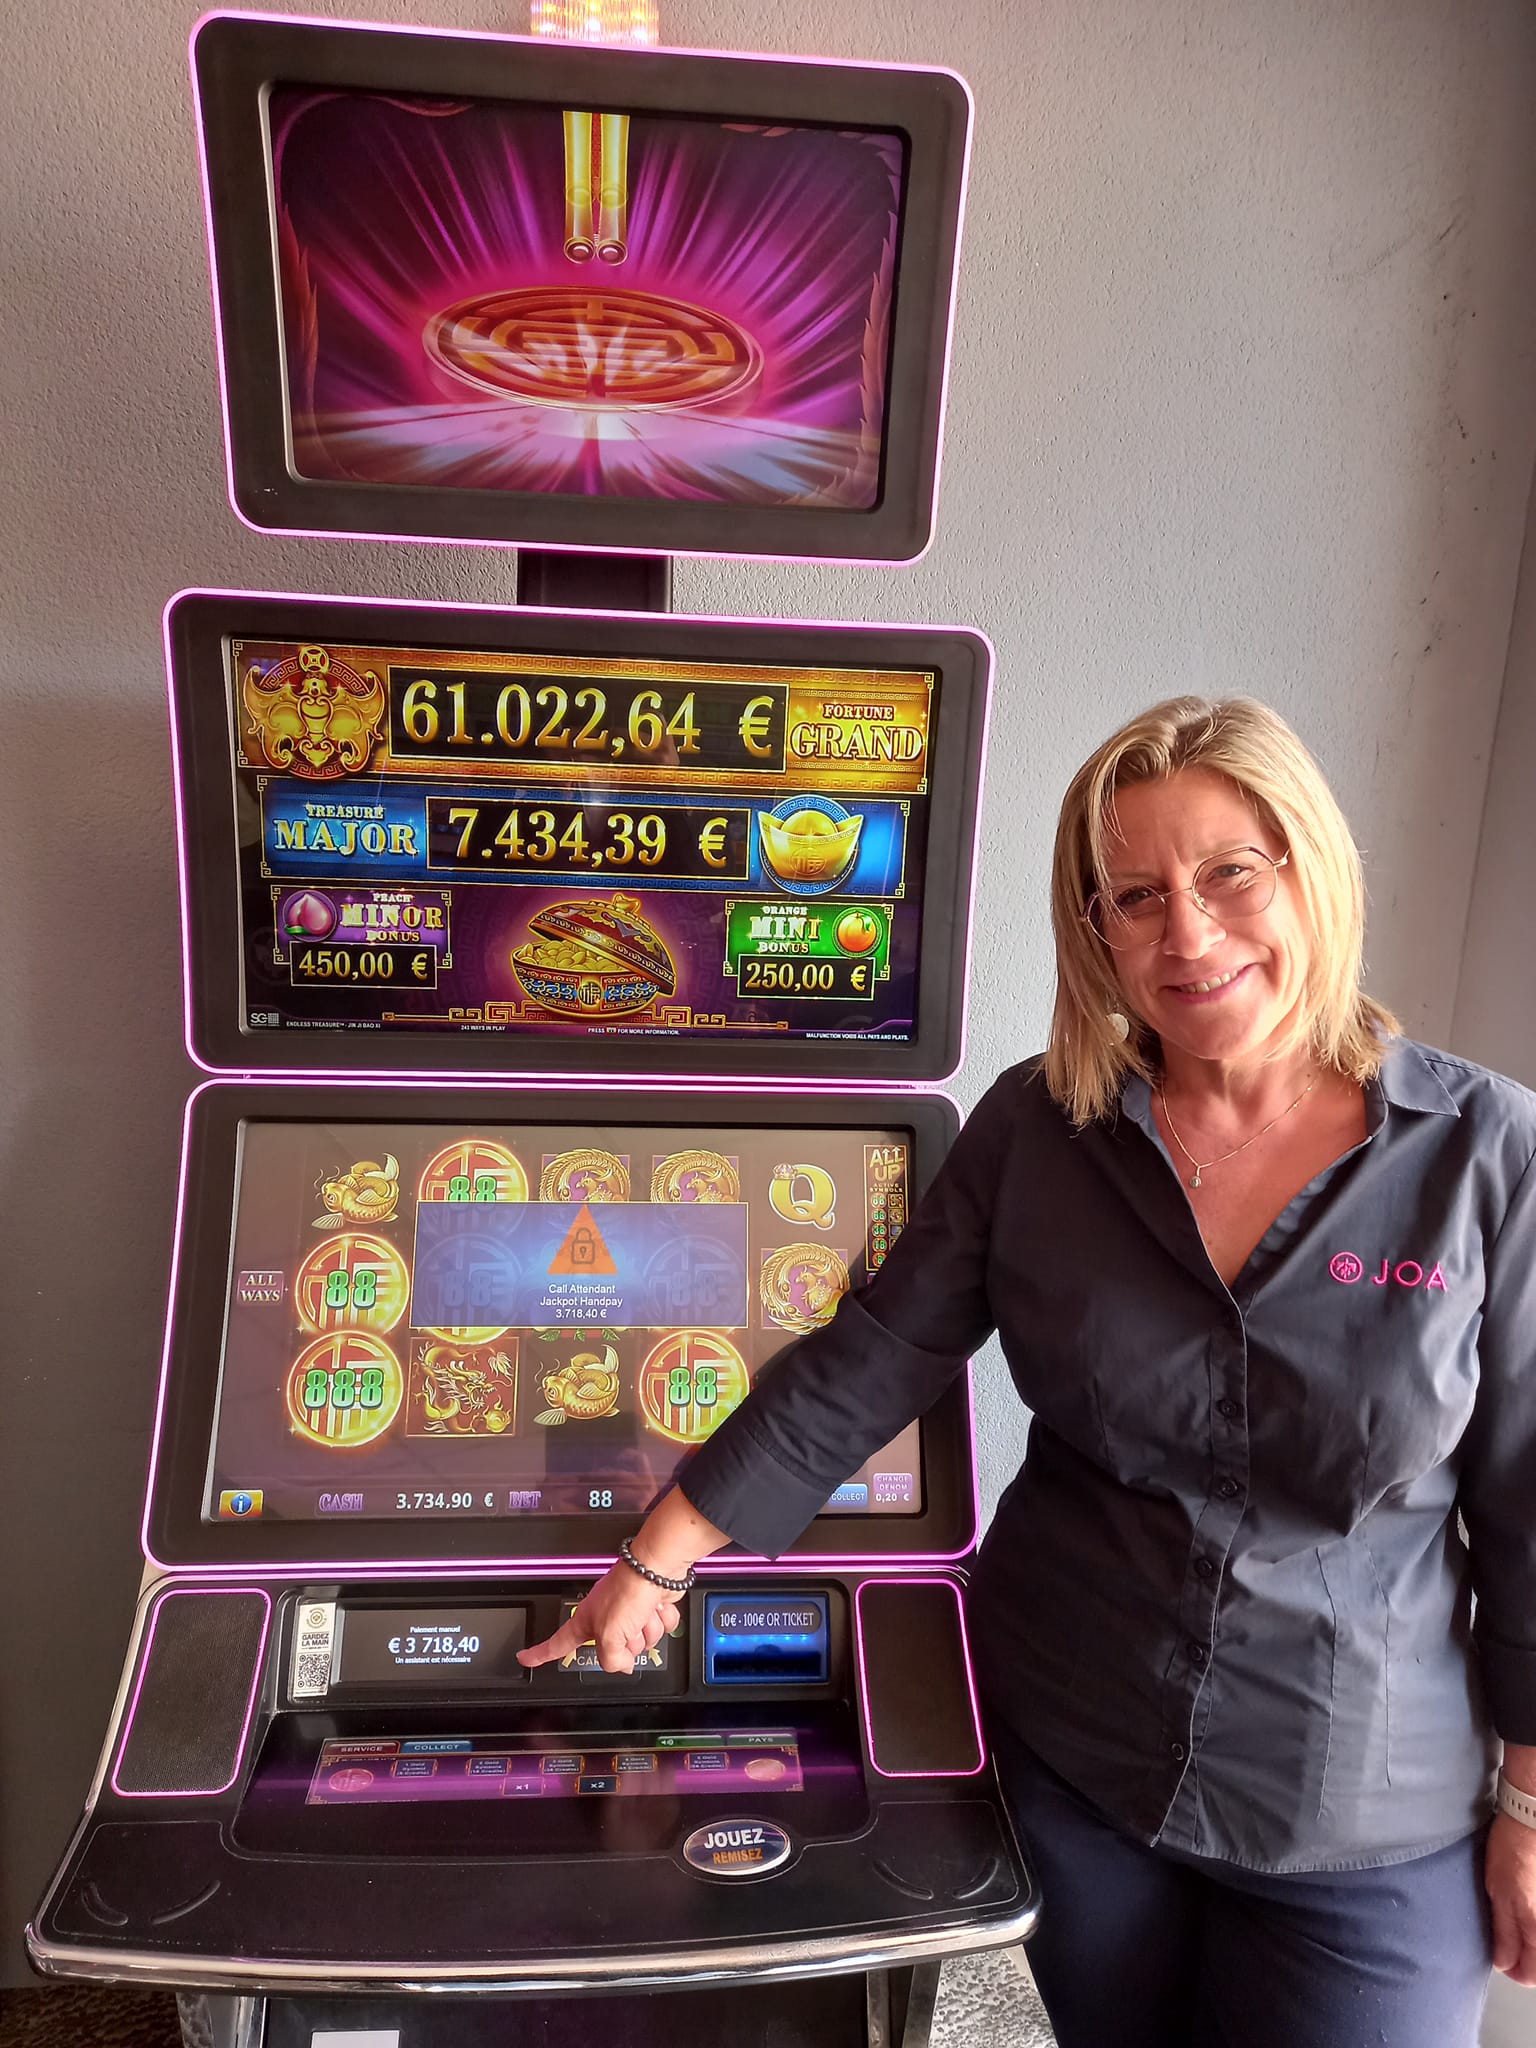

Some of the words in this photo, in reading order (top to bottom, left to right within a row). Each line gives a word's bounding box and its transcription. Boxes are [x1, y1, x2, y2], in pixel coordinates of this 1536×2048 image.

[402, 679, 701, 757] 61.022,64
[738, 695, 774, 759] €
[823, 703, 894, 720] FORTUNE
[790, 723, 923, 760] GRAND
[305, 804, 385, 819] TREASURE
[273, 819, 418, 856] MAJOR
[449, 808, 666, 868] 7.434,39
[699, 817, 728, 868] €
[373, 893, 414, 903] PEACH
[339, 903, 444, 928] MINOR
[762, 906, 807, 915] ORANGE
[366, 930, 420, 942] BONUS
[750, 916, 821, 940] MINI
[757, 941, 809, 953] BONUS
[299, 949, 393, 980] 450,00
[411, 953, 428, 979] €
[745, 962, 834, 991] 250,00
[851, 965, 867, 991] €
[874, 1163, 901, 1181] UP
[769, 1164, 837, 1230] Q
[245, 1275, 276, 1286] ALL
[1372, 1258, 1448, 1292] JOA
[240, 1290, 281, 1302] WAYS
[326, 1270, 377, 1309] 88
[548, 1284, 568, 1294] Call
[569, 1284, 616, 1294] Attendant
[540, 1297, 577, 1308] Jackpot
[580, 1297, 623, 1308] Handpay
[600, 1309, 608, 1318] €
[304, 1368, 384, 1409] 888
[669, 1367, 718, 1407] 88
[319, 1493, 363, 1511] CASH
[396, 1492, 472, 1510] 3.734,90
[484, 1492, 493, 1508] €
[508, 1491, 541, 1509] BET
[588, 1490, 613, 1508] 88
[831, 1492, 865, 1501] COLLECT
[875, 1493, 897, 1503] 0,20
[720, 1613, 737, 1627] 10€
[743, 1612, 765, 1627] 100€
[766, 1612, 780, 1626] OR
[782, 1612, 814, 1626] TICKET
[302, 1633, 329, 1641] GARDEZ
[388, 1637, 401, 1653] €
[422, 1636, 480, 1656] 718,40
[590, 1781, 606, 1789] x2
[704, 1828, 765, 1849] JOUEZ
[712, 1848, 763, 1865] REMISEZ
